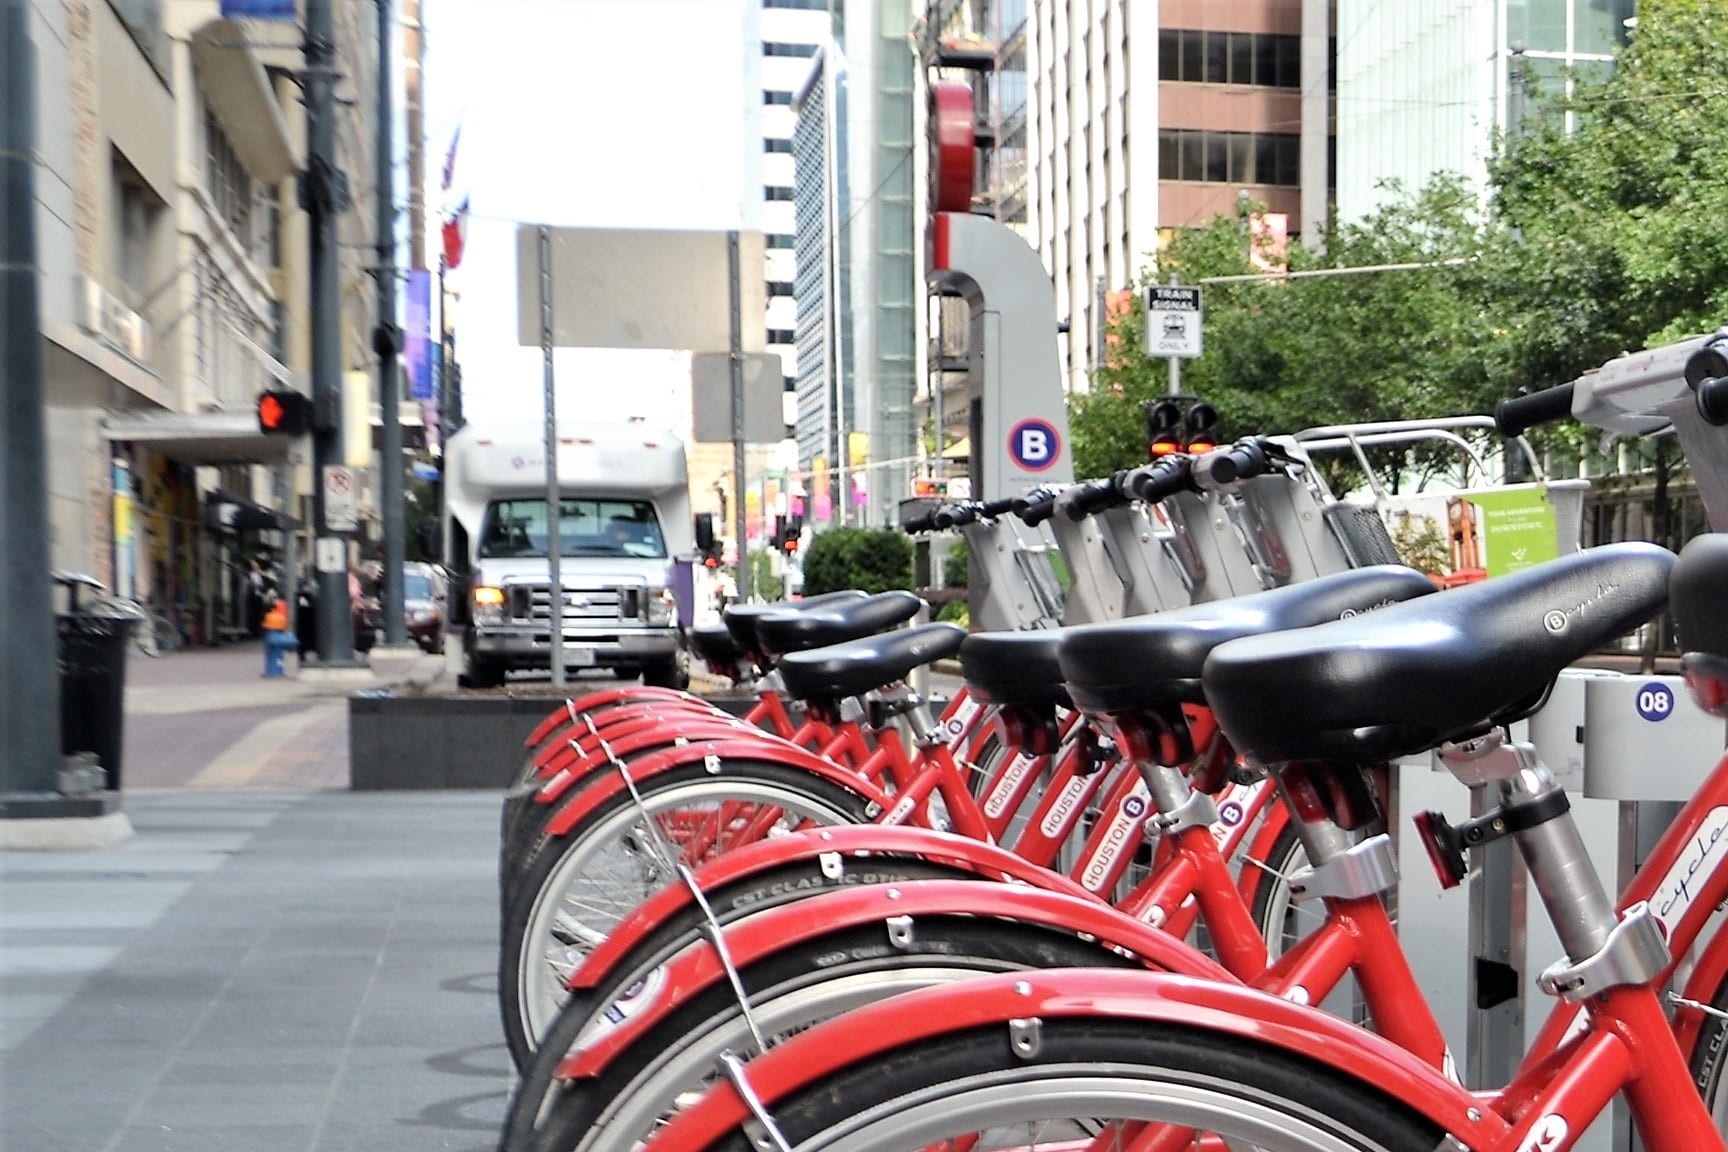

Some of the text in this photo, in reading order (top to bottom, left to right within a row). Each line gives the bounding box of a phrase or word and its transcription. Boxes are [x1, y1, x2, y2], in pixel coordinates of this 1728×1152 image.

[1156, 289, 1194, 300] TRAIN
[1152, 300, 1198, 312] SIGNAL
[1158, 341, 1188, 350] ONLY
[1489, 520, 1542, 533] DOWNTOWN
[1640, 692, 1668, 712] 08
[989, 759, 1028, 815] HOUSTON
[1086, 818, 1131, 887] HOUSTON
[771, 873, 857, 893] CLASIC
